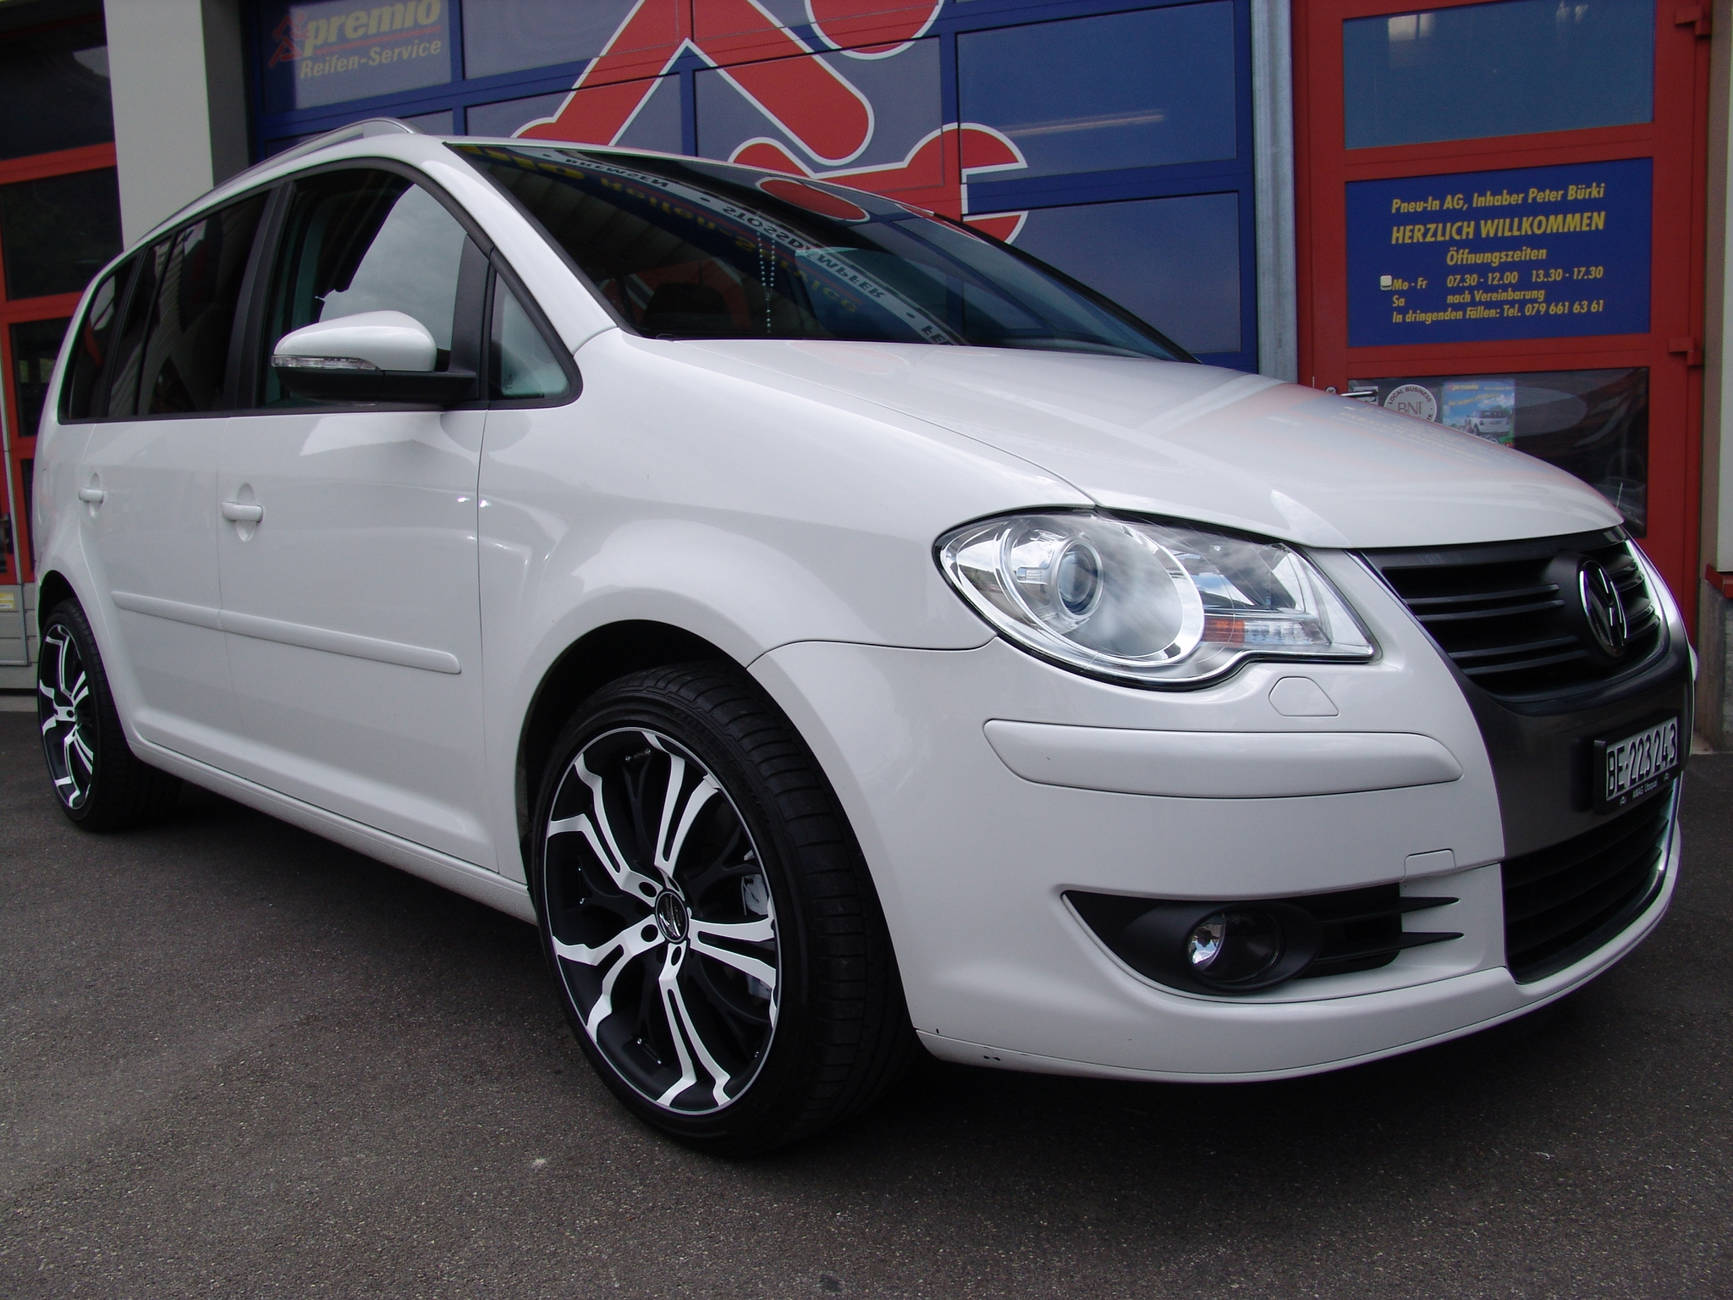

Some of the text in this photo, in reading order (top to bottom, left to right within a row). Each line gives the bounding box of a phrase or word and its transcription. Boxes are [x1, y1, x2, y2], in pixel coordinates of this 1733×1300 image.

[303, 0, 441, 57] premio
[301, 39, 442, 79] Reifen-Service
[1391, 181, 1605, 214] Pneu-In AG, Inhaber Peter Bürki
[1391, 211, 1606, 244] HERZLICH WILLKOMMEN
[1446, 246, 1548, 267] Öffnungszeiten
[1392, 278, 1409, 291] Mo
[1417, 277, 1428, 289] Fr
[1446, 274, 1479, 287] 07.30
[1487, 271, 1519, 285] 12.00
[1531, 268, 1564, 283] 13.30
[1573, 265, 1604, 280] 17.30
[1392, 287, 1545, 307] Sa nach Vereinbarung
[1392, 299, 1604, 324] In dringenden Fällen: Tel. 079 661 63 61
